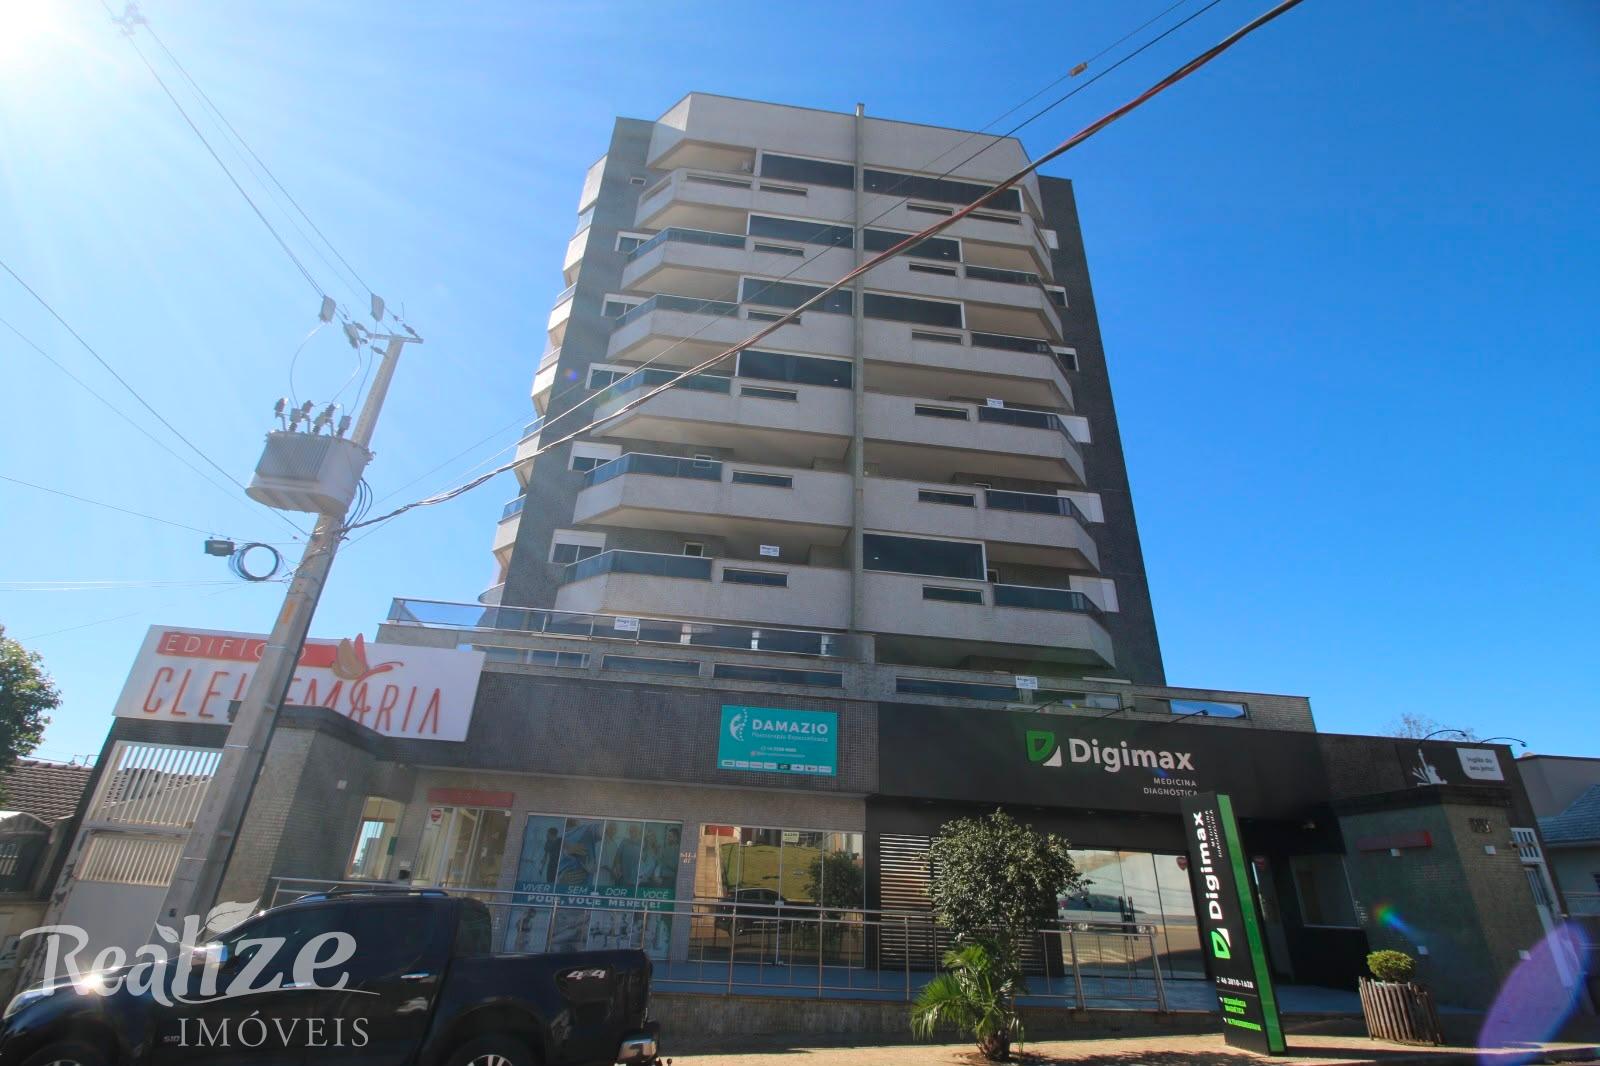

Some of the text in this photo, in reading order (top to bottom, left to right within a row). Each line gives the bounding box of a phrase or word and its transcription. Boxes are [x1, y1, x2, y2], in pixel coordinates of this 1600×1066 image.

[752, 719, 828, 735] DAMAZIO
[1068, 738, 1195, 773] Digimax
[1153, 777, 1197, 787] MEDICINA
[1193, 811, 1223, 920] Digimax
[522, 883, 551, 893] VIVER
[567, 885, 589, 895] SEM
[605, 887, 628, 897] DOR
